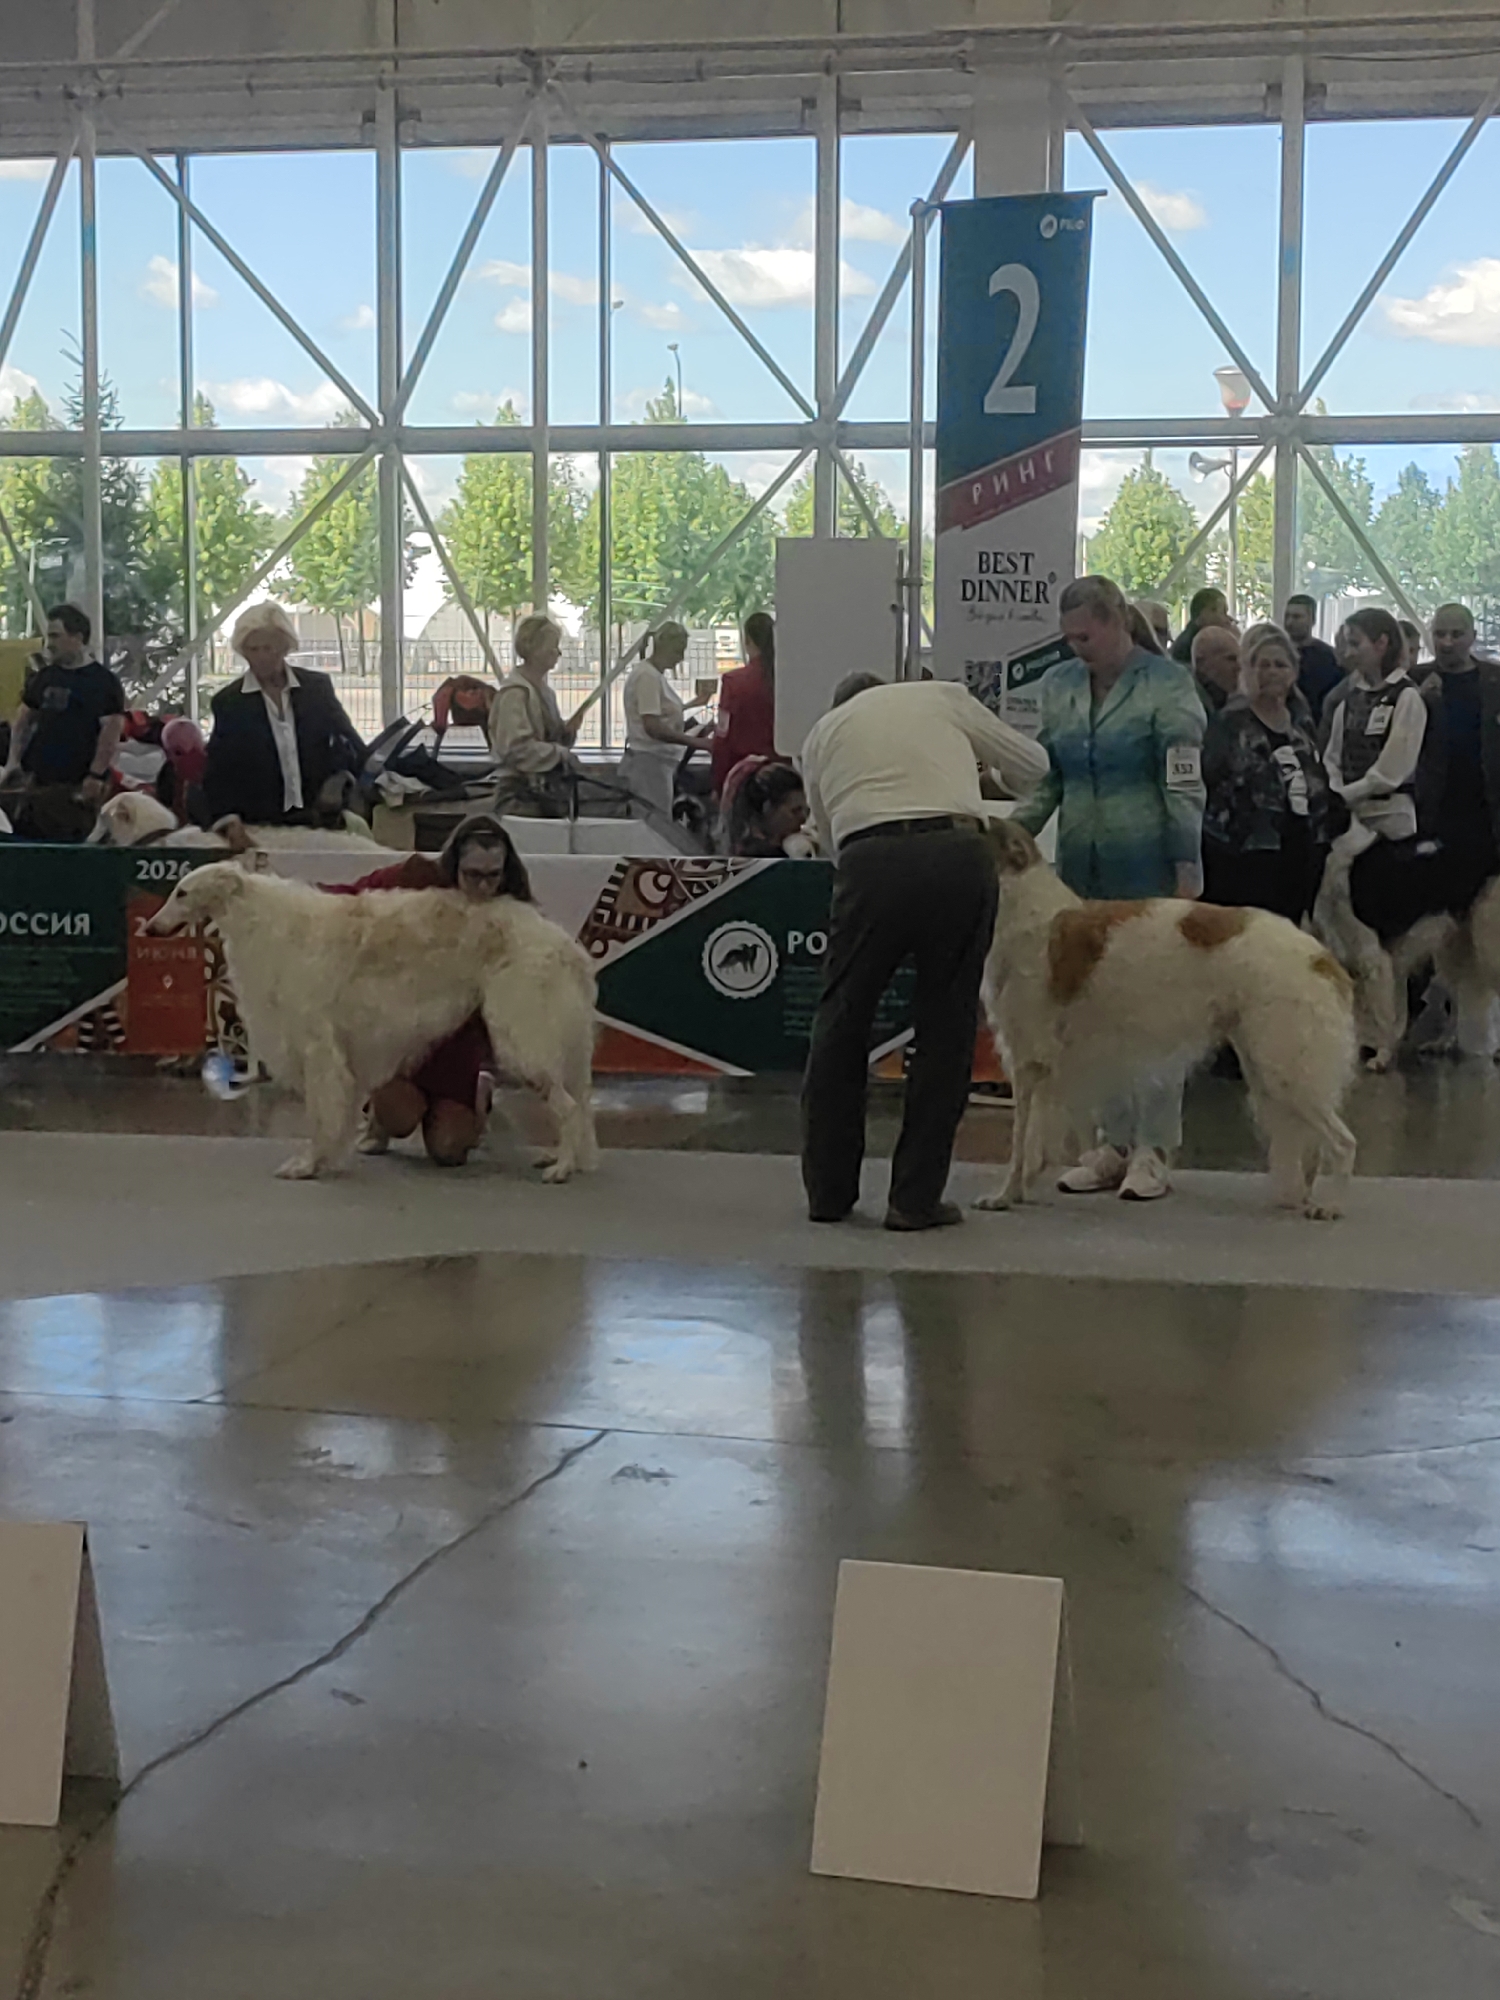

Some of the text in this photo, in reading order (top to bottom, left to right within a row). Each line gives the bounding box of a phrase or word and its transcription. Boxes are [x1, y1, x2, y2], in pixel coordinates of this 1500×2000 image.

[983, 263, 1041, 414] 2
[972, 450, 1054, 505] РИНГ
[978, 551, 1036, 575] BEST
[961, 579, 1050, 604] DINNER
[136, 859, 192, 880] 2026
